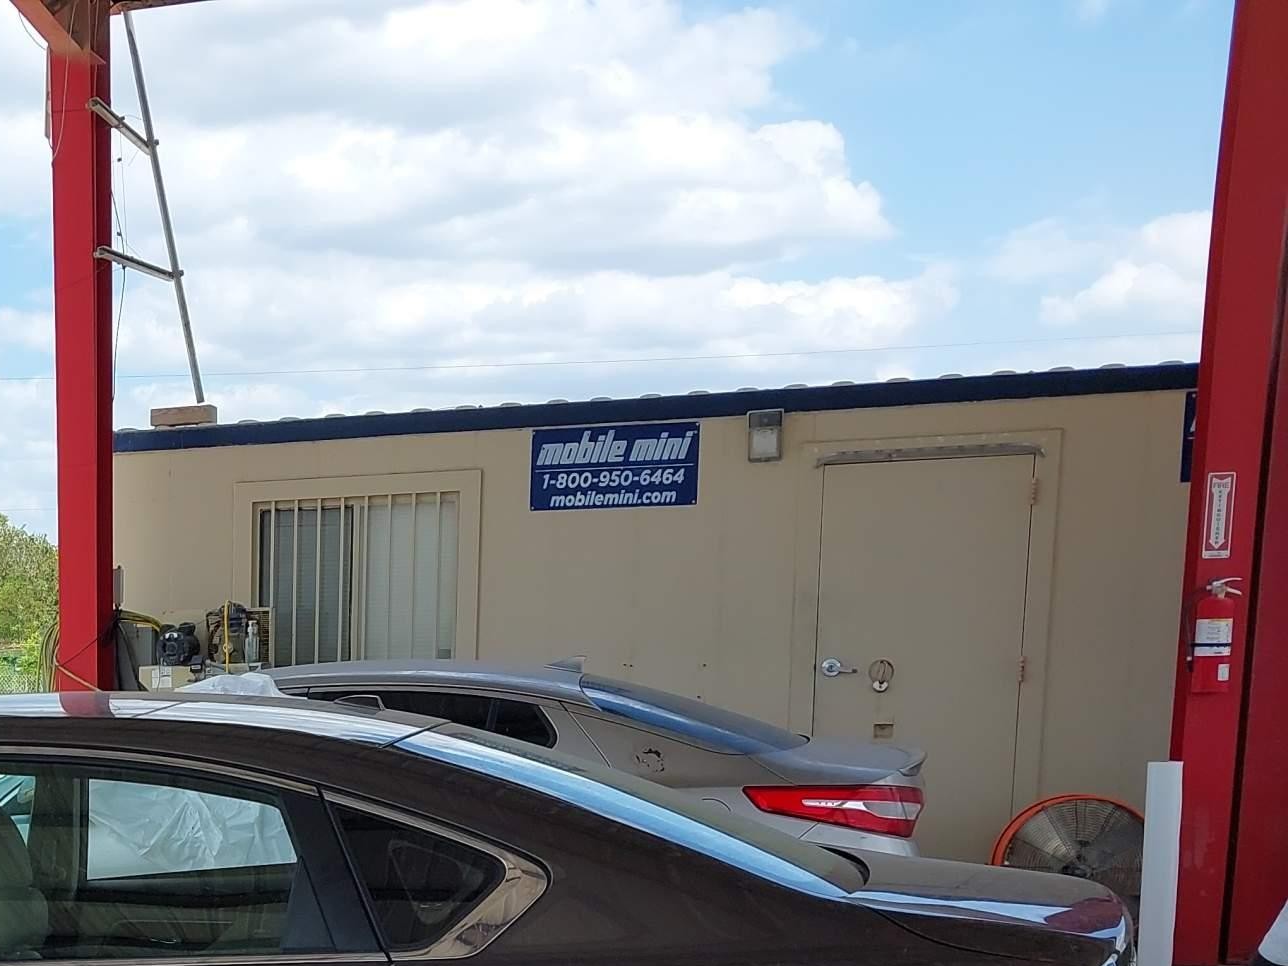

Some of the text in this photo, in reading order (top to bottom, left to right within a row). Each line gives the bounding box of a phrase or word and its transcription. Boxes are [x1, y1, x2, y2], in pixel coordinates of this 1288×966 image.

[536, 430, 692, 465] mobile mini
[543, 468, 685, 489] 1-800-950-6464
[550, 489, 677, 508] mobilemini.com
